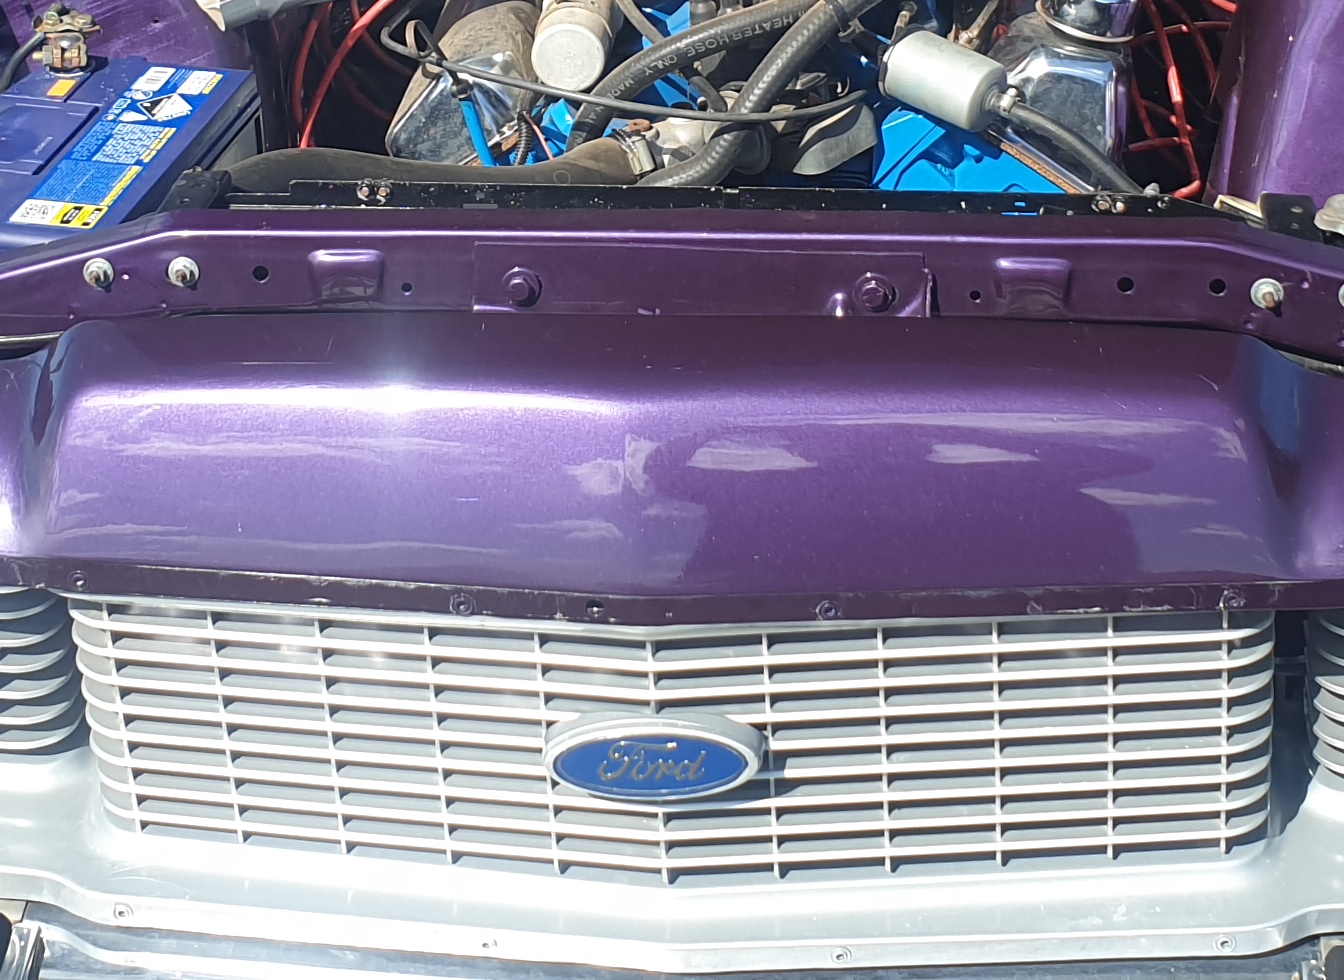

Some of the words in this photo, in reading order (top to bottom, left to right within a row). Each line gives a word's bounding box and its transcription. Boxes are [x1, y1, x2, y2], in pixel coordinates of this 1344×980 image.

[733, 18, 794, 40] HEATER
[684, 37, 730, 58] HOSE
[644, 54, 677, 76] ONLY
[597, 739, 706, 782] Ford
